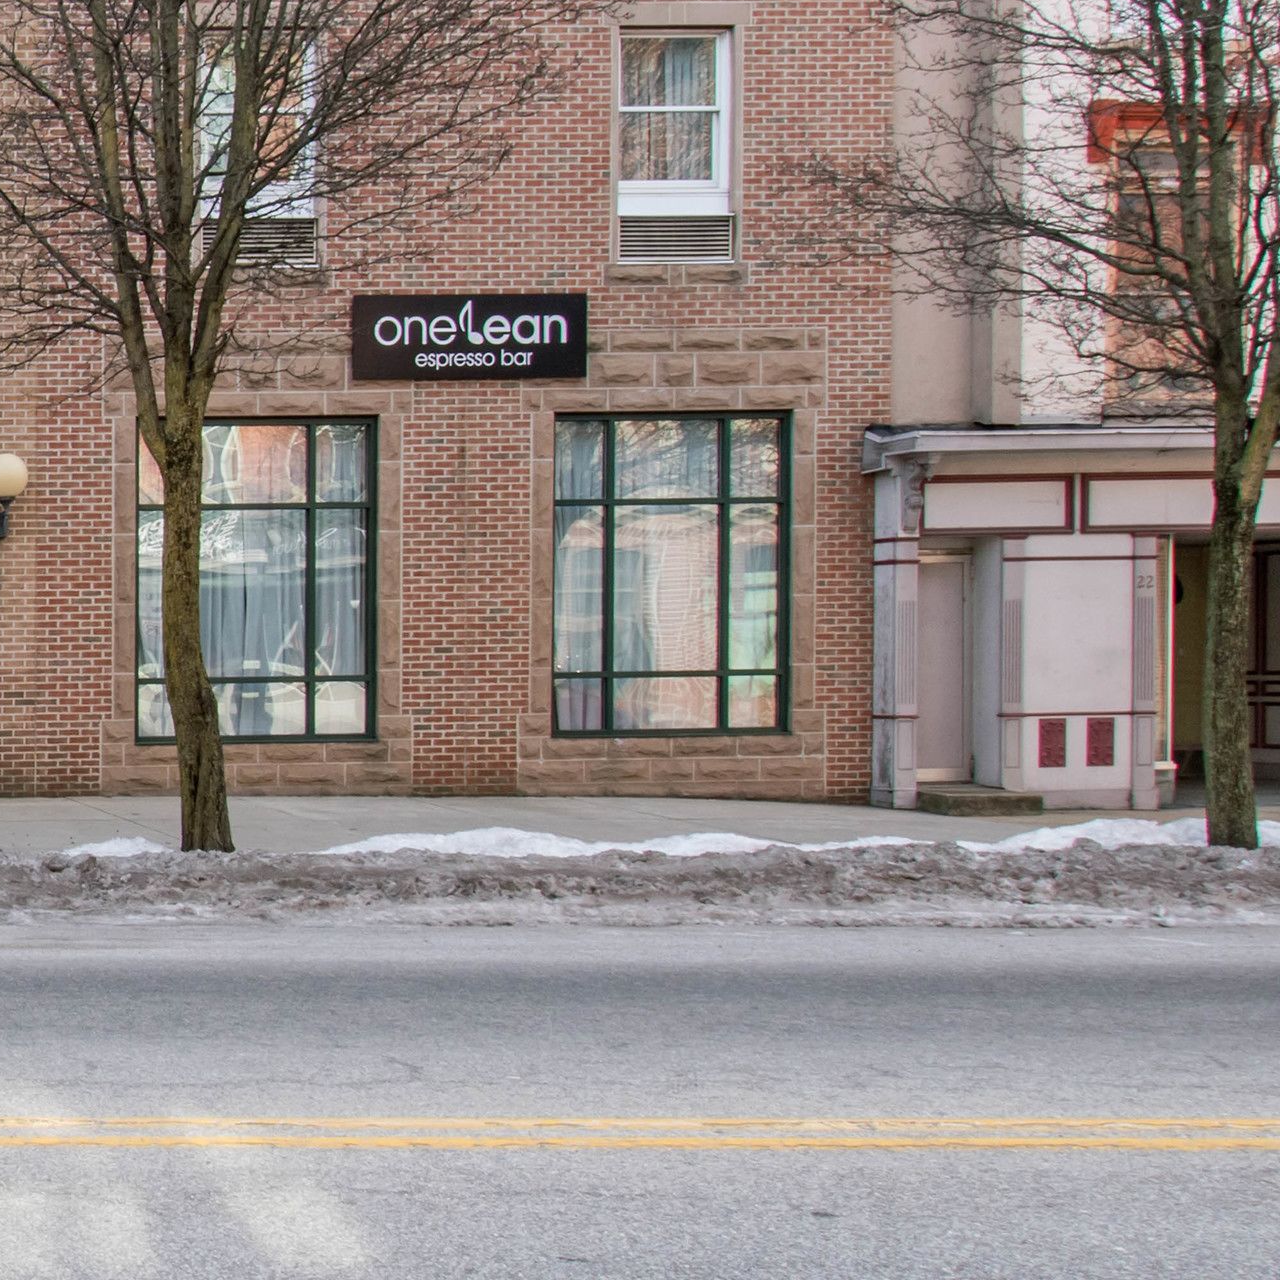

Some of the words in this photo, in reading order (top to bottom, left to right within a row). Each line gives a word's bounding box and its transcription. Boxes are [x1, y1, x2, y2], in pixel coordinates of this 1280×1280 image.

[414, 351, 495, 370] espresso
[500, 348, 533, 366] bar
[1136, 574, 1154, 589] 22
